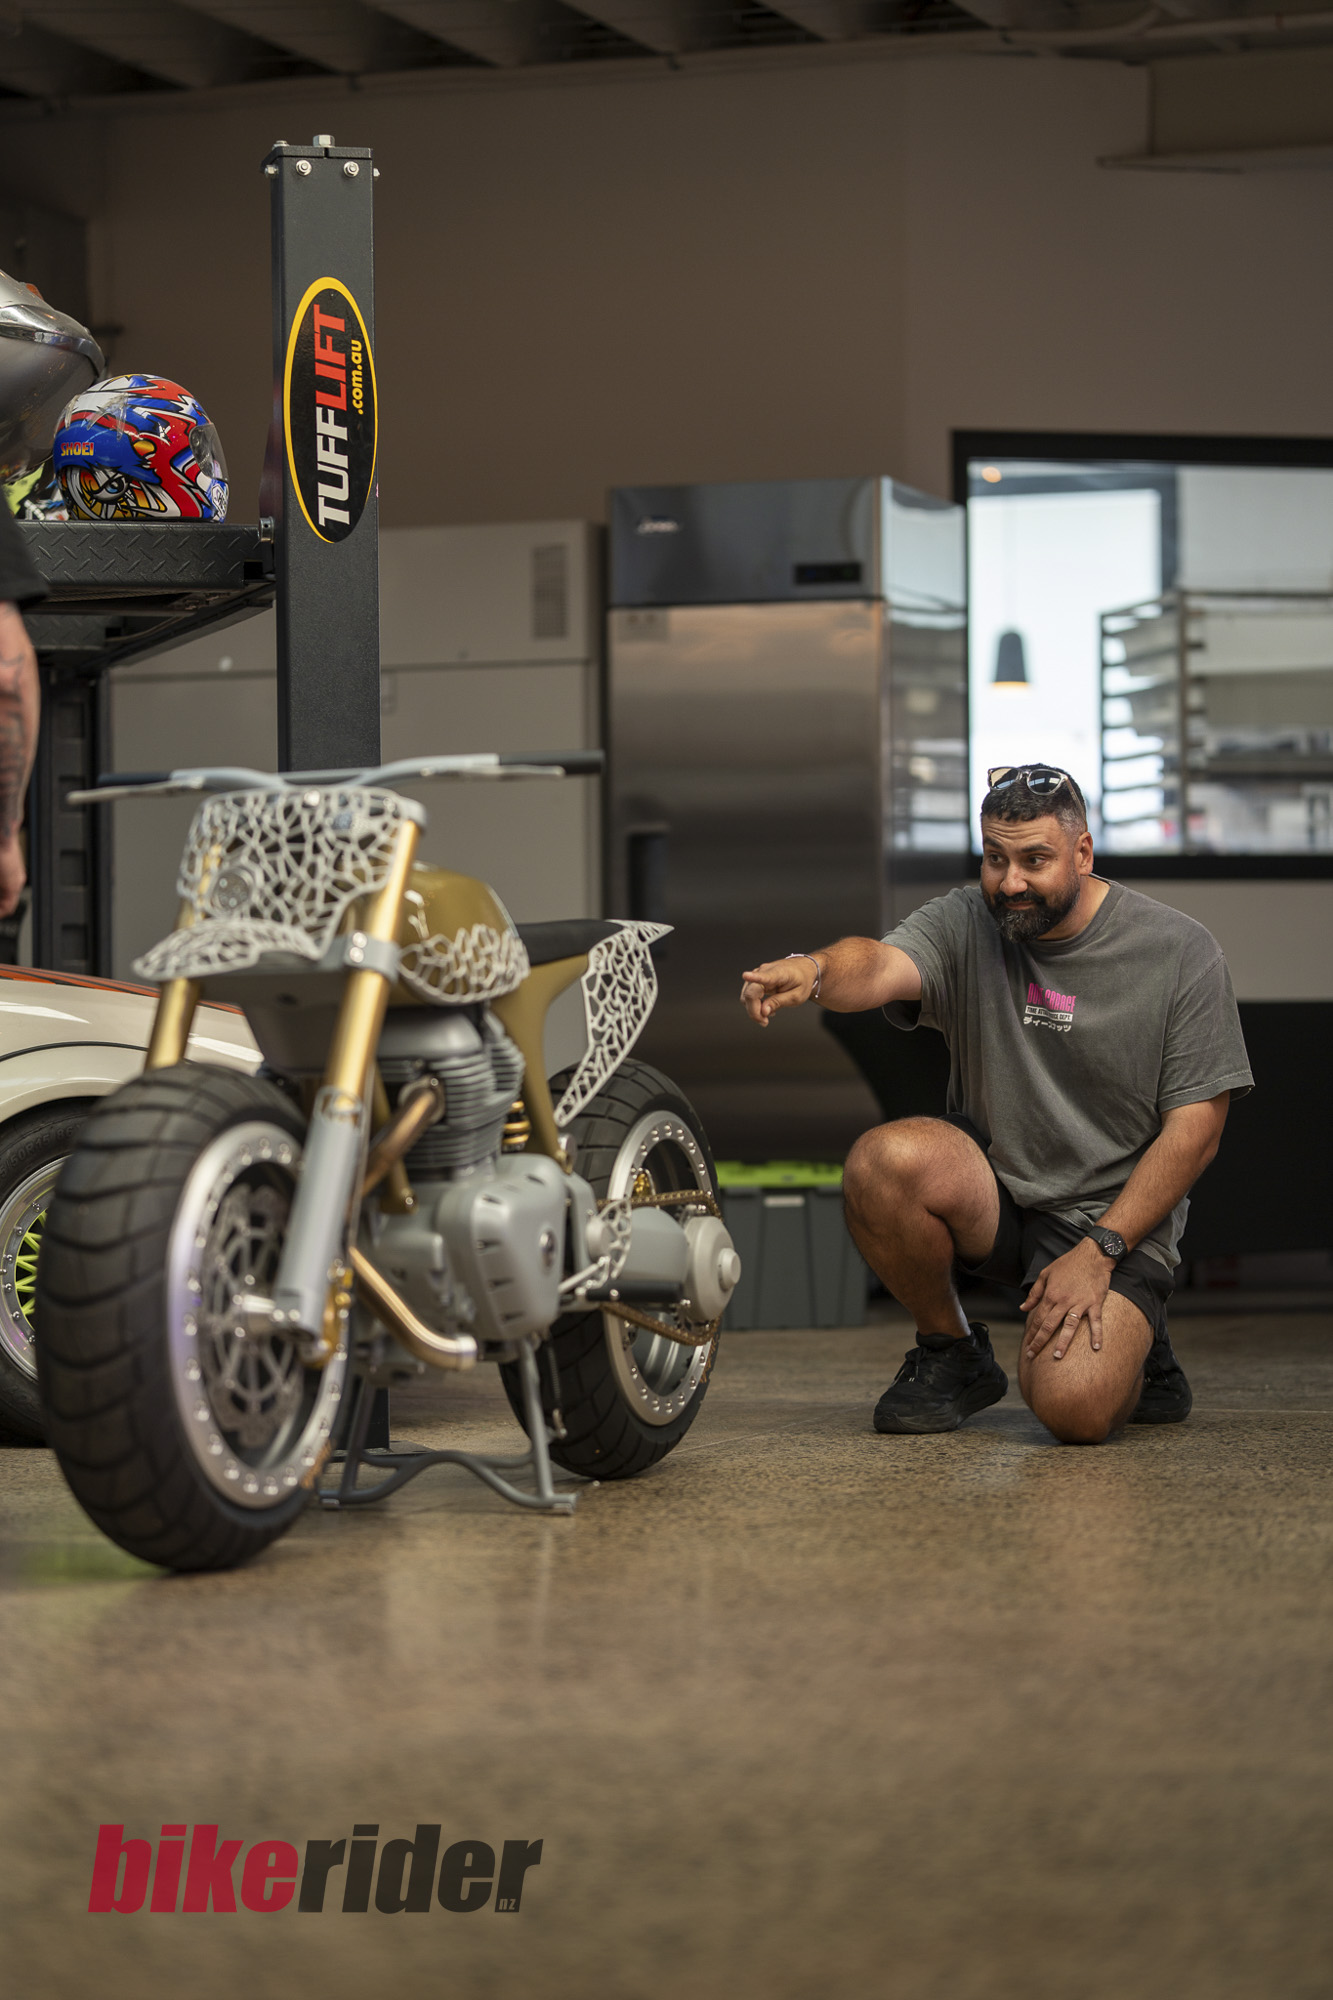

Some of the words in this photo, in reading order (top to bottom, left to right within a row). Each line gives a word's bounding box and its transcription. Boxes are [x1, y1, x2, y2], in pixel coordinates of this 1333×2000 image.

[313, 303, 350, 527] TUFFLIFT
[351, 339, 363, 415] .com.au
[61, 442, 95, 457] SHOEI
